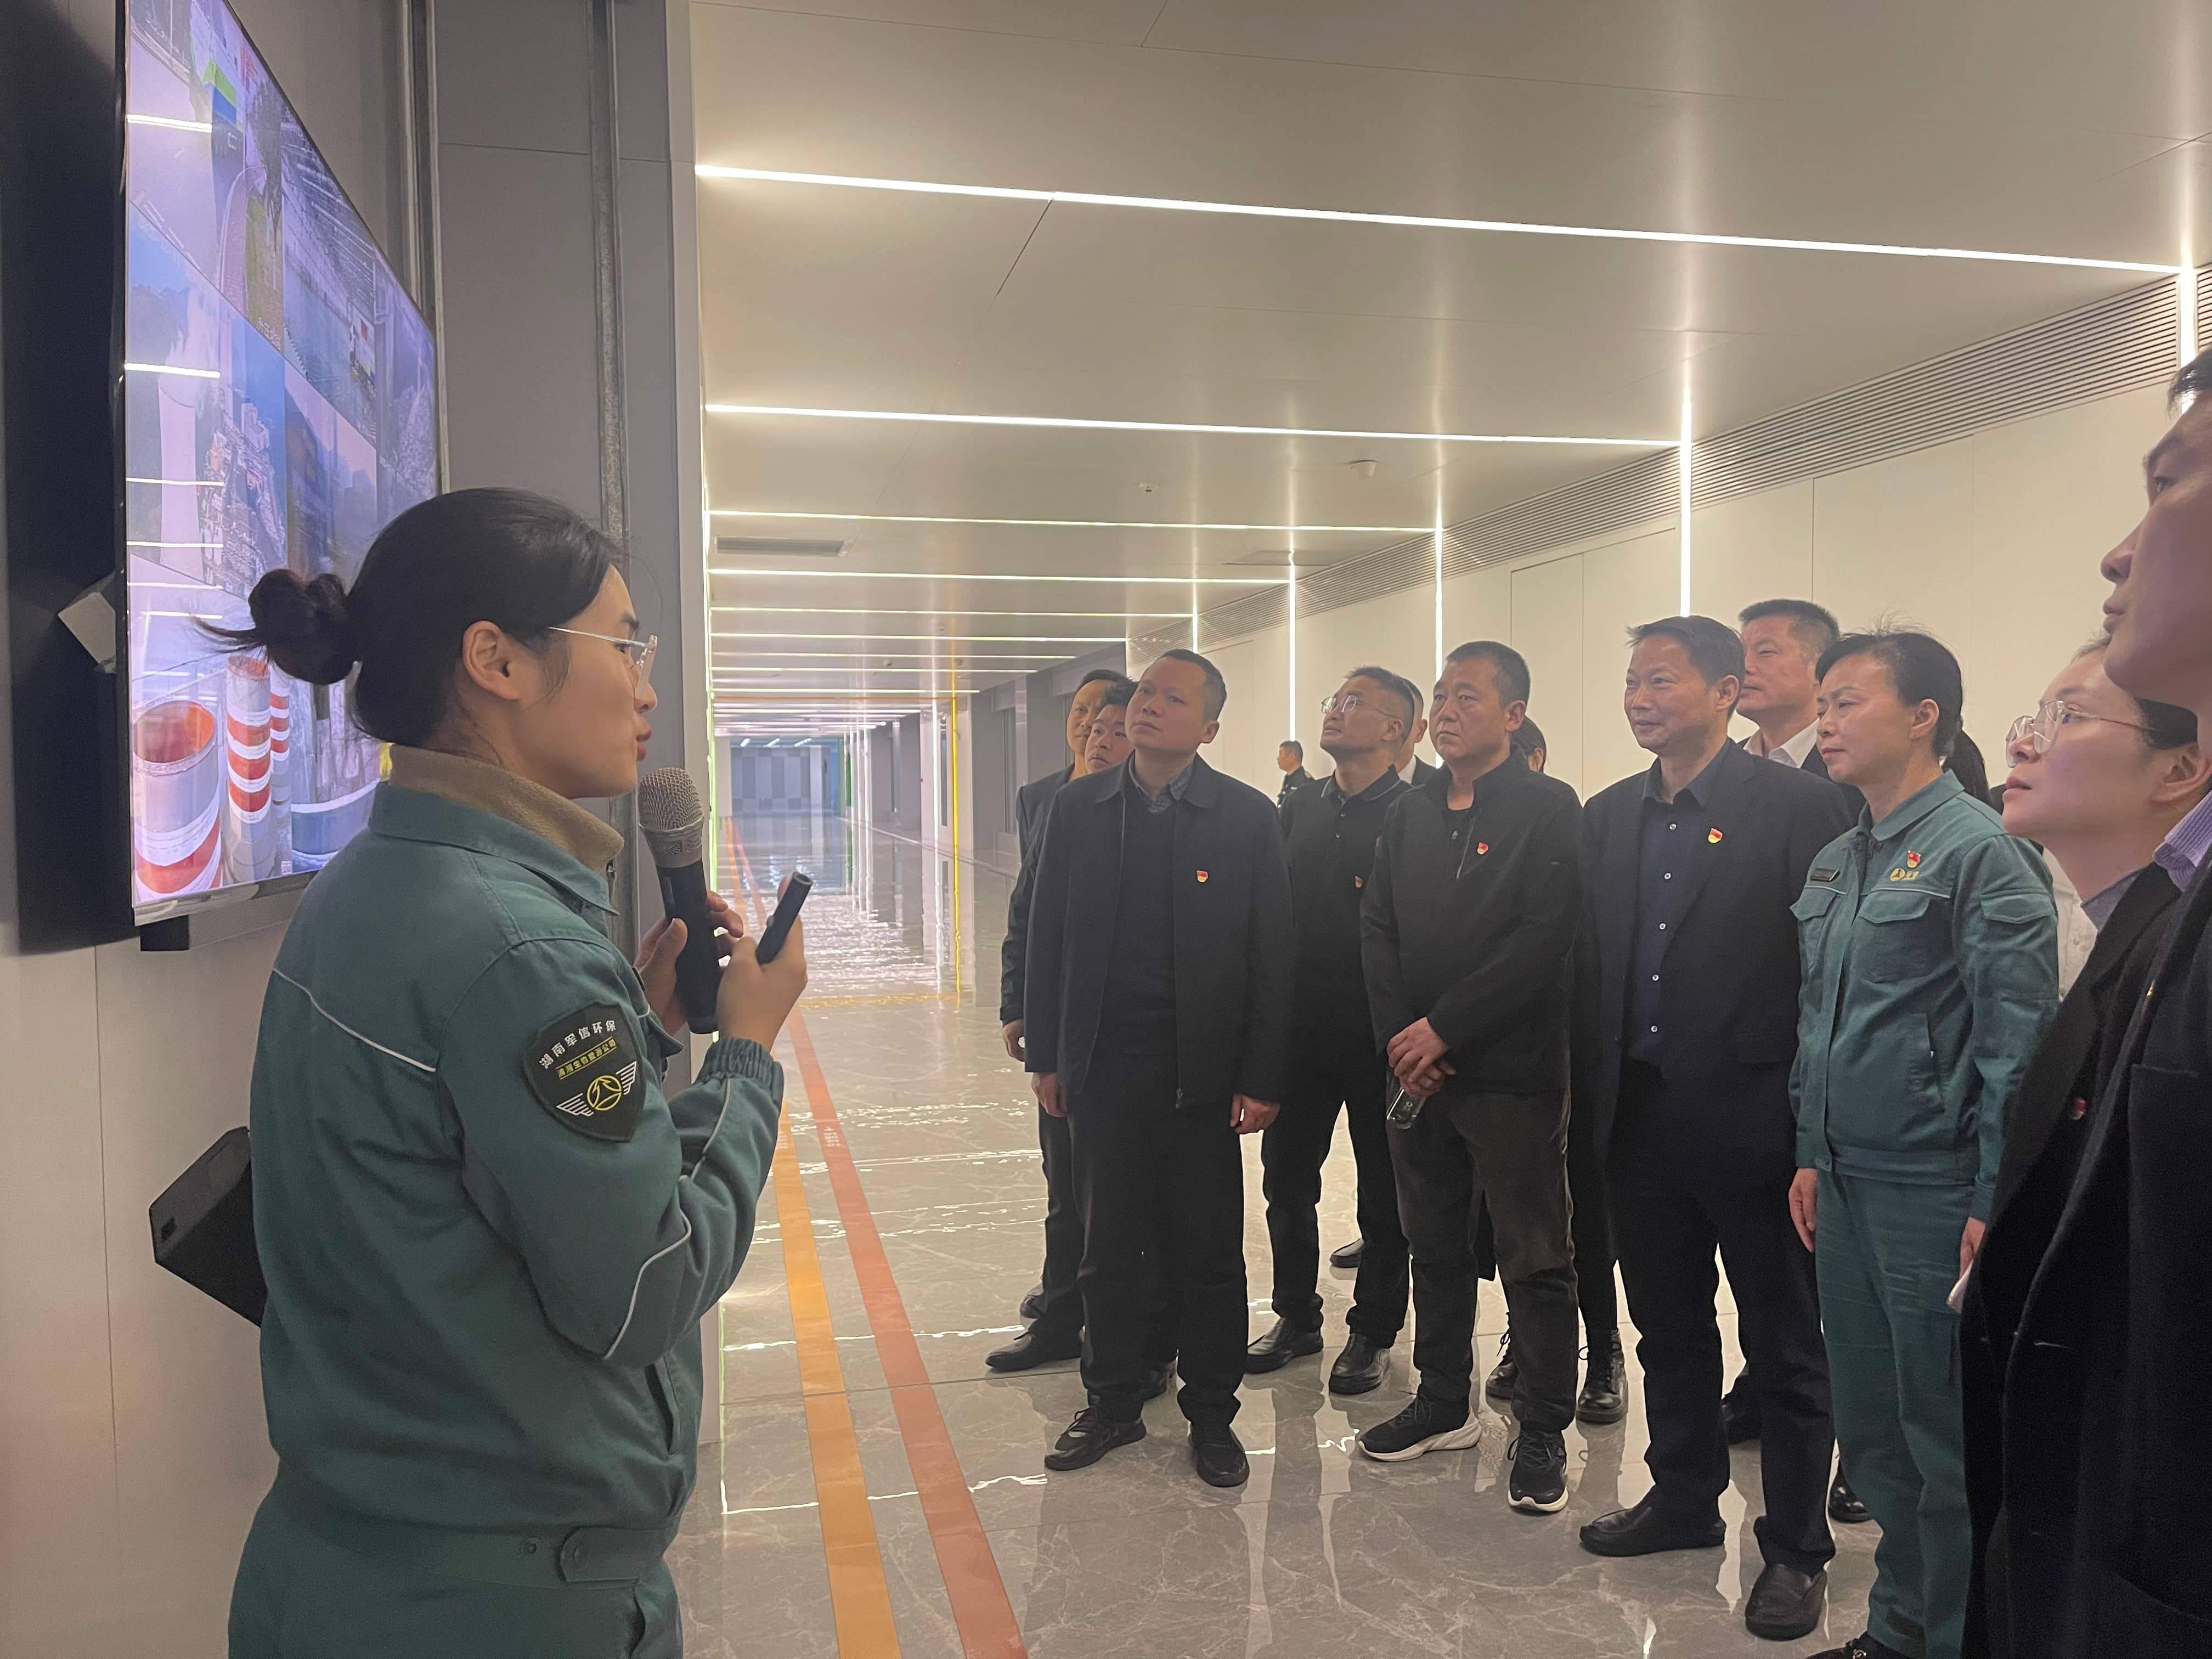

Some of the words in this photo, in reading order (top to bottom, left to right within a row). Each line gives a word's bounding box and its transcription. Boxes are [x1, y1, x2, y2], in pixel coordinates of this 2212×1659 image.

[539, 1020, 617, 1069] 湖南军信环保
